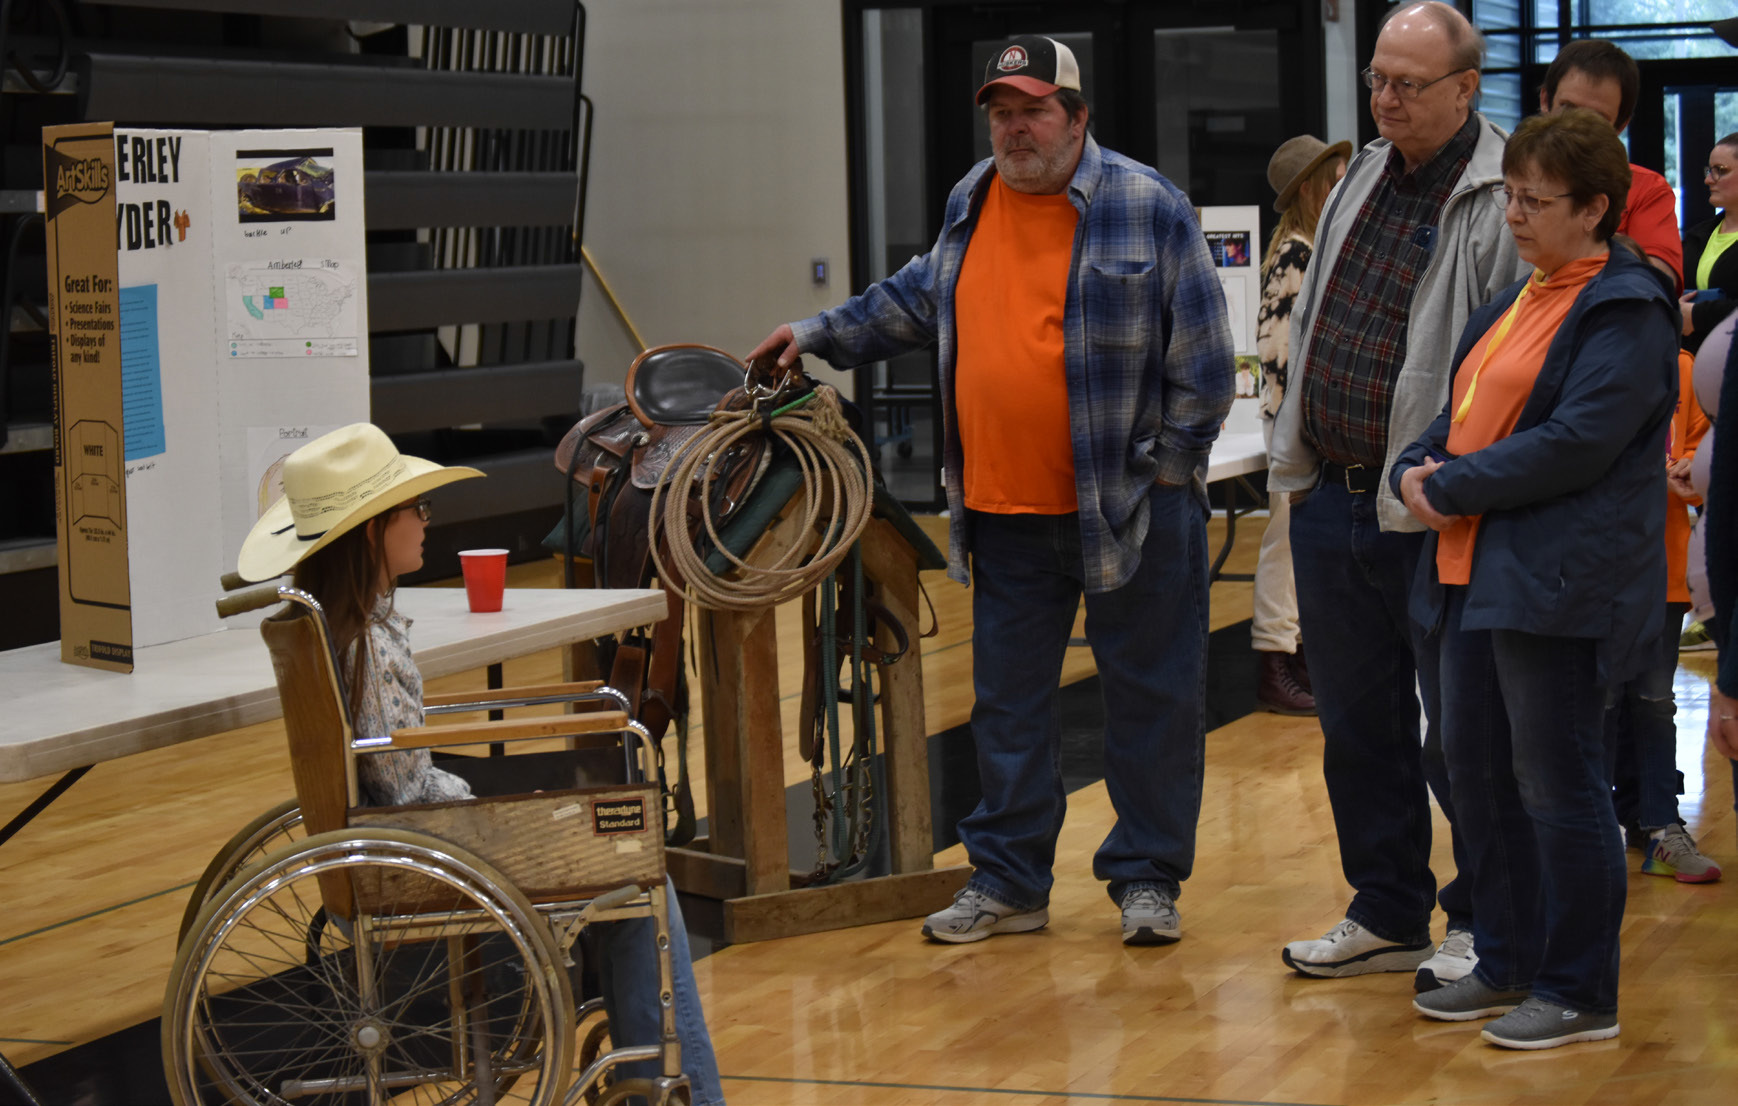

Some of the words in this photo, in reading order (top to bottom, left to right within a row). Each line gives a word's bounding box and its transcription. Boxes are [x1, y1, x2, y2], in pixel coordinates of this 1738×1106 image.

[116, 134, 182, 184] ERLEY
[56, 157, 109, 192] ArtSkills
[64, 275, 90, 294] Great
[92, 274, 113, 294] For:
[69, 301, 93, 315] Science
[94, 301, 112, 315] Fairs
[70, 318, 115, 331] Presentations
[70, 334, 97, 349] Displays
[97, 334, 106, 348] of
[70, 352, 82, 365] any
[83, 350, 101, 363] kind!
[83, 444, 104, 457] WHITE
[596, 805, 642, 817] theradyne
[599, 817, 641, 829] Standard
